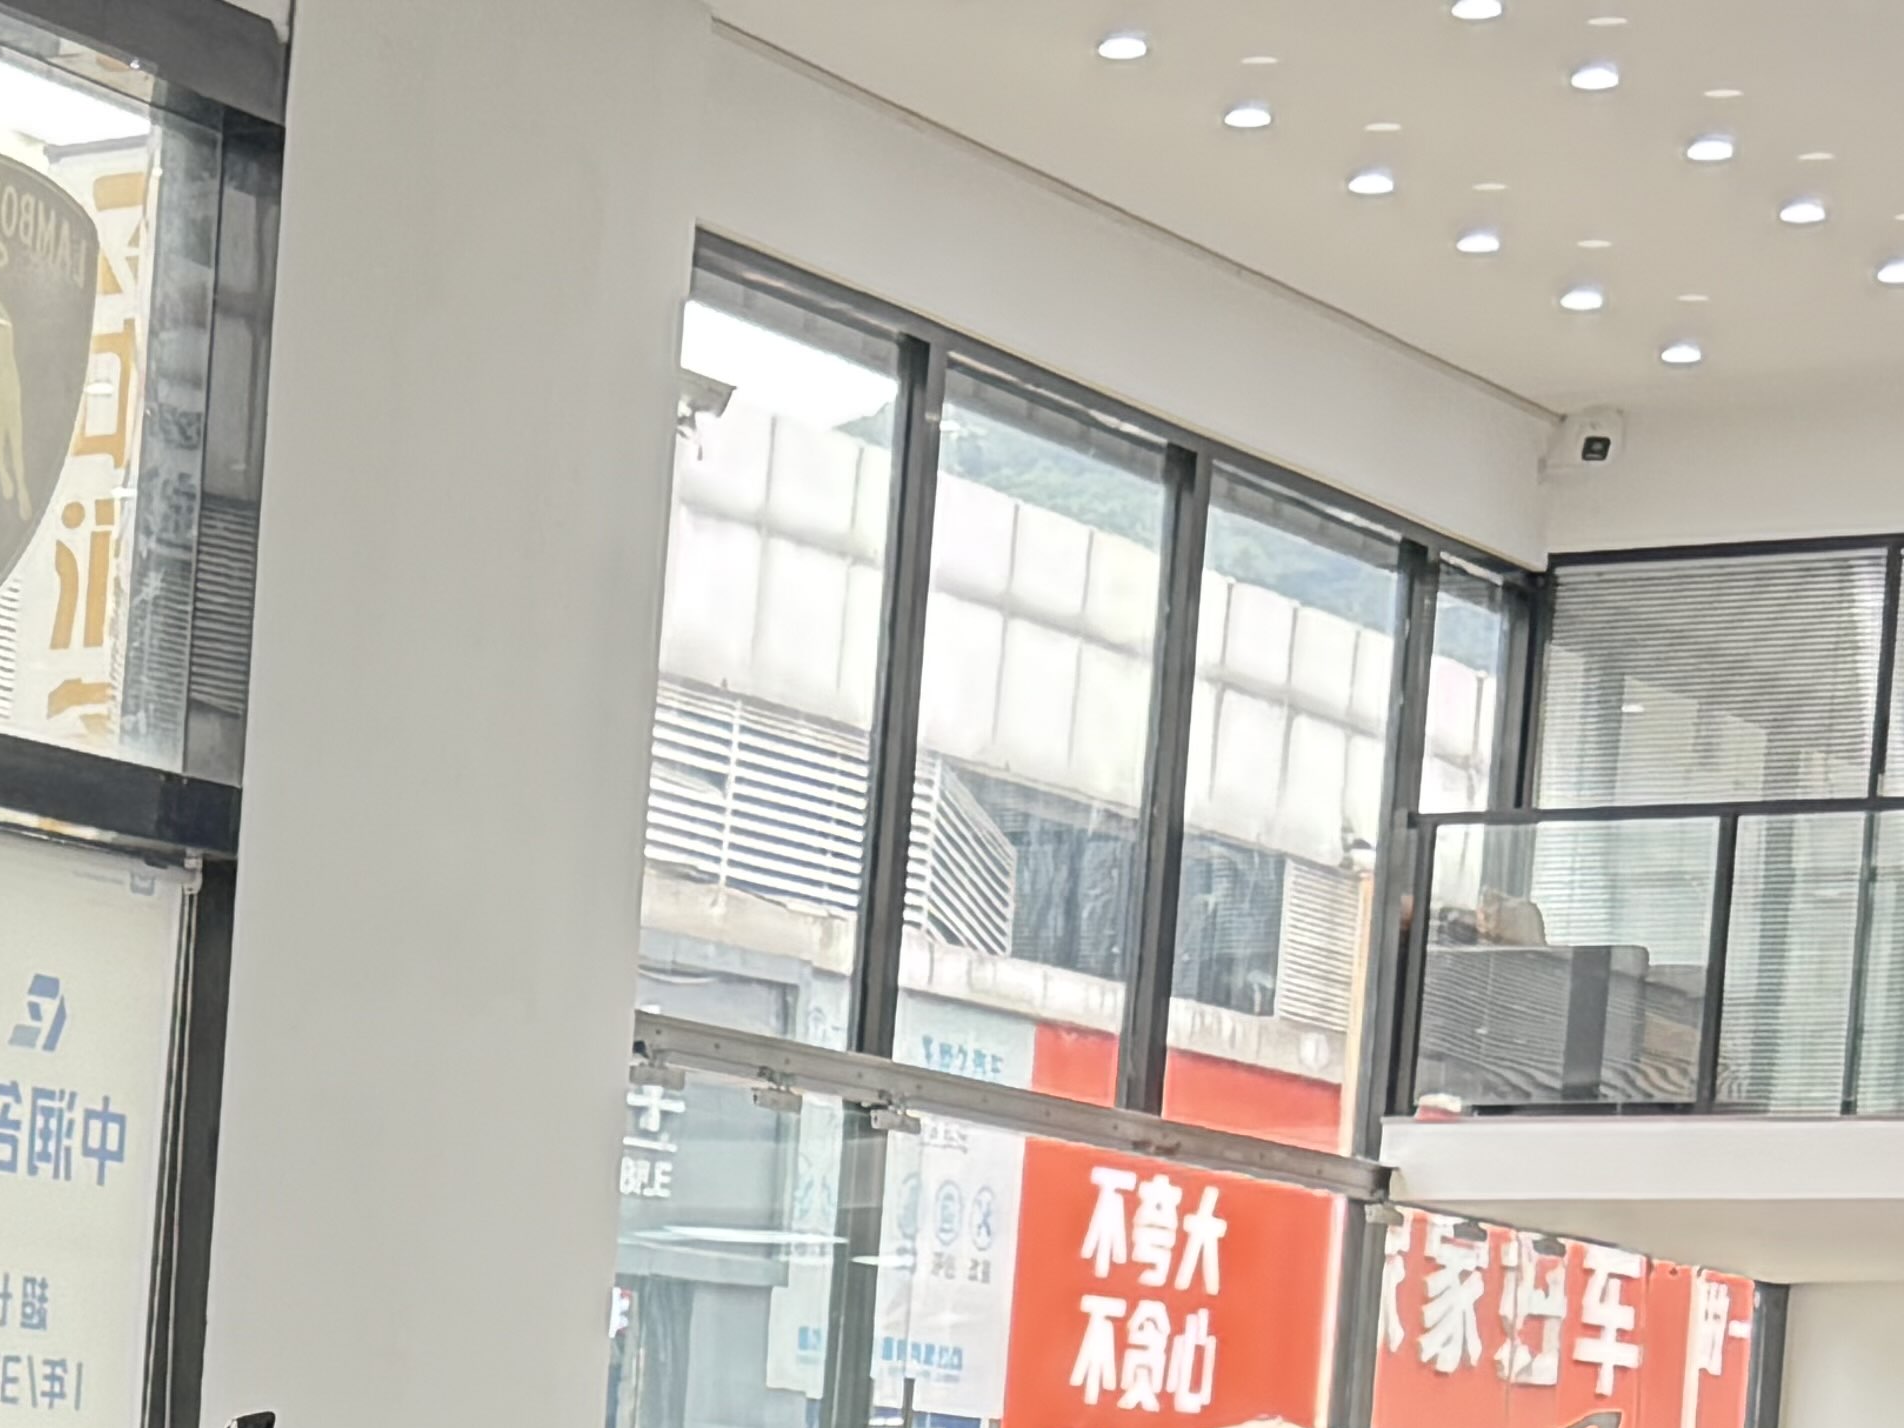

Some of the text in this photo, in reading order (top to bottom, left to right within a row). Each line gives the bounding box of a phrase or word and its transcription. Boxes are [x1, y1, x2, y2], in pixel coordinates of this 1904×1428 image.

[1080, 1166, 1228, 1295] 不夸大
[1069, 1294, 1218, 1414] 不贪心
